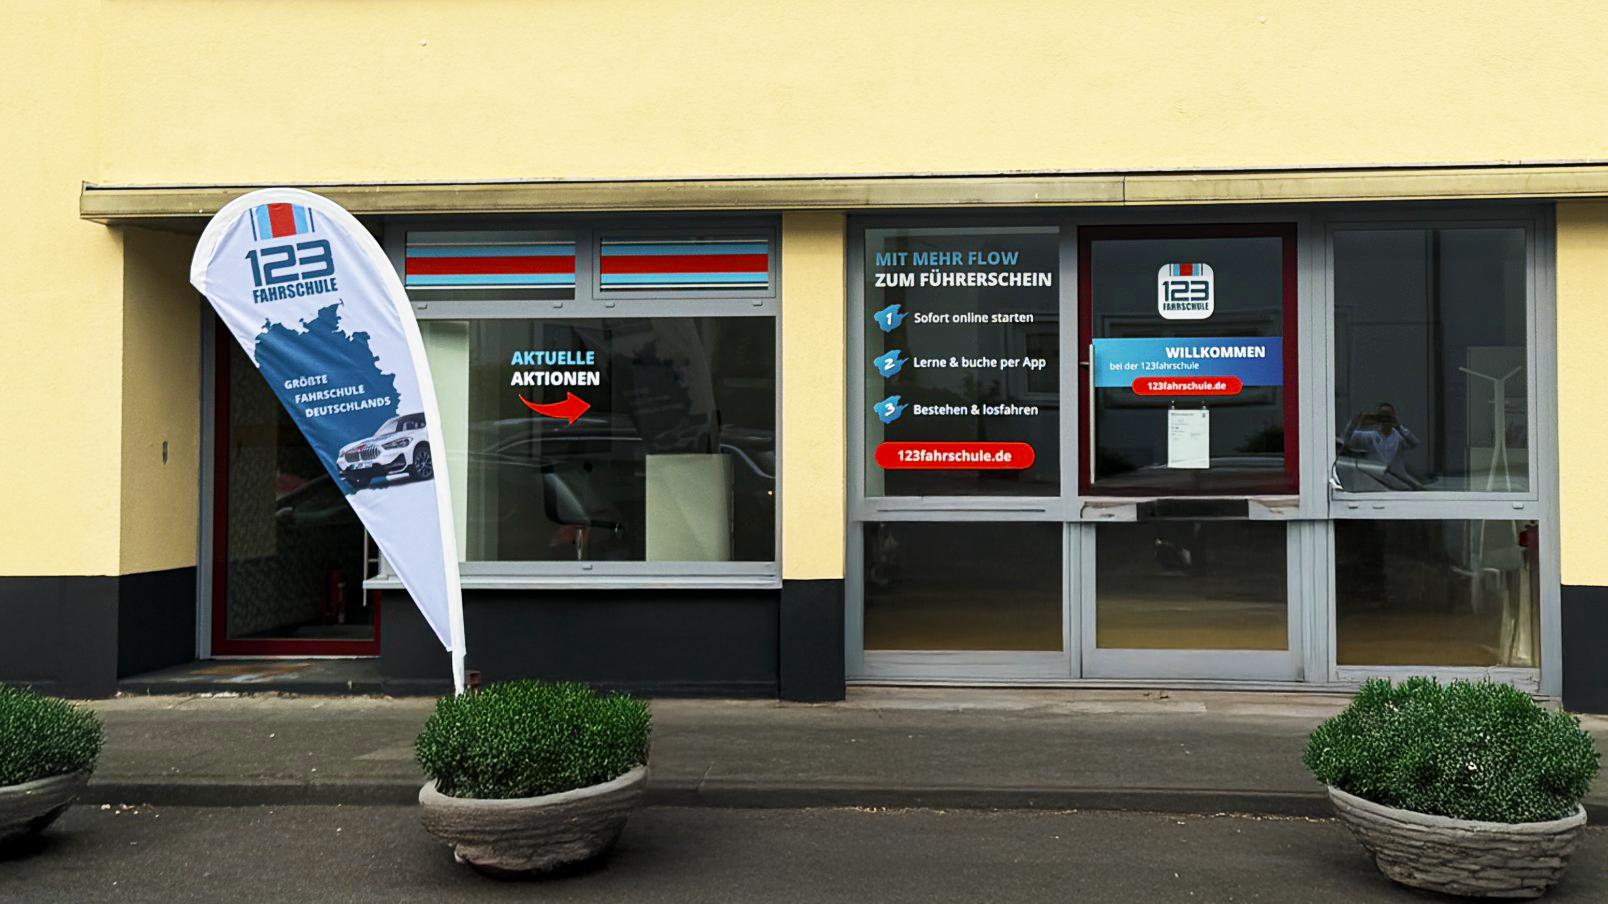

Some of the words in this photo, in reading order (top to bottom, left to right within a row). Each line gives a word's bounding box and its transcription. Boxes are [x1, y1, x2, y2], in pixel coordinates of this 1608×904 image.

[245, 239, 335, 287] 123
[875, 252, 908, 266] MIT
[912, 252, 963, 266] MEHR
[968, 251, 1019, 265] FLOW
[875, 273, 915, 287] ZUM
[920, 269, 1052, 287] FÜHRERSCHEIN
[253, 277, 338, 304] FAHRSCHULE
[1162, 281, 1209, 302] 123
[1163, 302, 1209, 311] FAHRSCHULE
[886, 312, 892, 325] 1
[914, 312, 950, 323] Sofort
[952, 312, 988, 323] online
[991, 313, 1034, 323] starten
[511, 351, 595, 366] AKTUELLE
[1165, 346, 1265, 358] WILLKOMMEN
[884, 358, 895, 370] 2
[914, 357, 946, 368] Lerne
[949, 357, 959, 367] &
[962, 357, 997, 367] buche
[1000, 358, 1020, 370] per
[1022, 357, 1046, 370] App
[1109, 362, 1123, 371] bei
[1124, 362, 1138, 371] der
[1141, 361, 1199, 371] 123fahrschule
[510, 371, 600, 386] AKTIONEN
[1147, 381, 1227, 391] 123fahrschule.de
[295, 384, 365, 404] FAHRSCHULE
[305, 396, 391, 418] DEUTSCHLANDS
[884, 403, 895, 416] 3
[914, 404, 968, 415] Bestehen
[971, 404, 980, 415] &
[982, 404, 1039, 415] losfahren
[897, 450, 1012, 462] 123fahrschule.de
